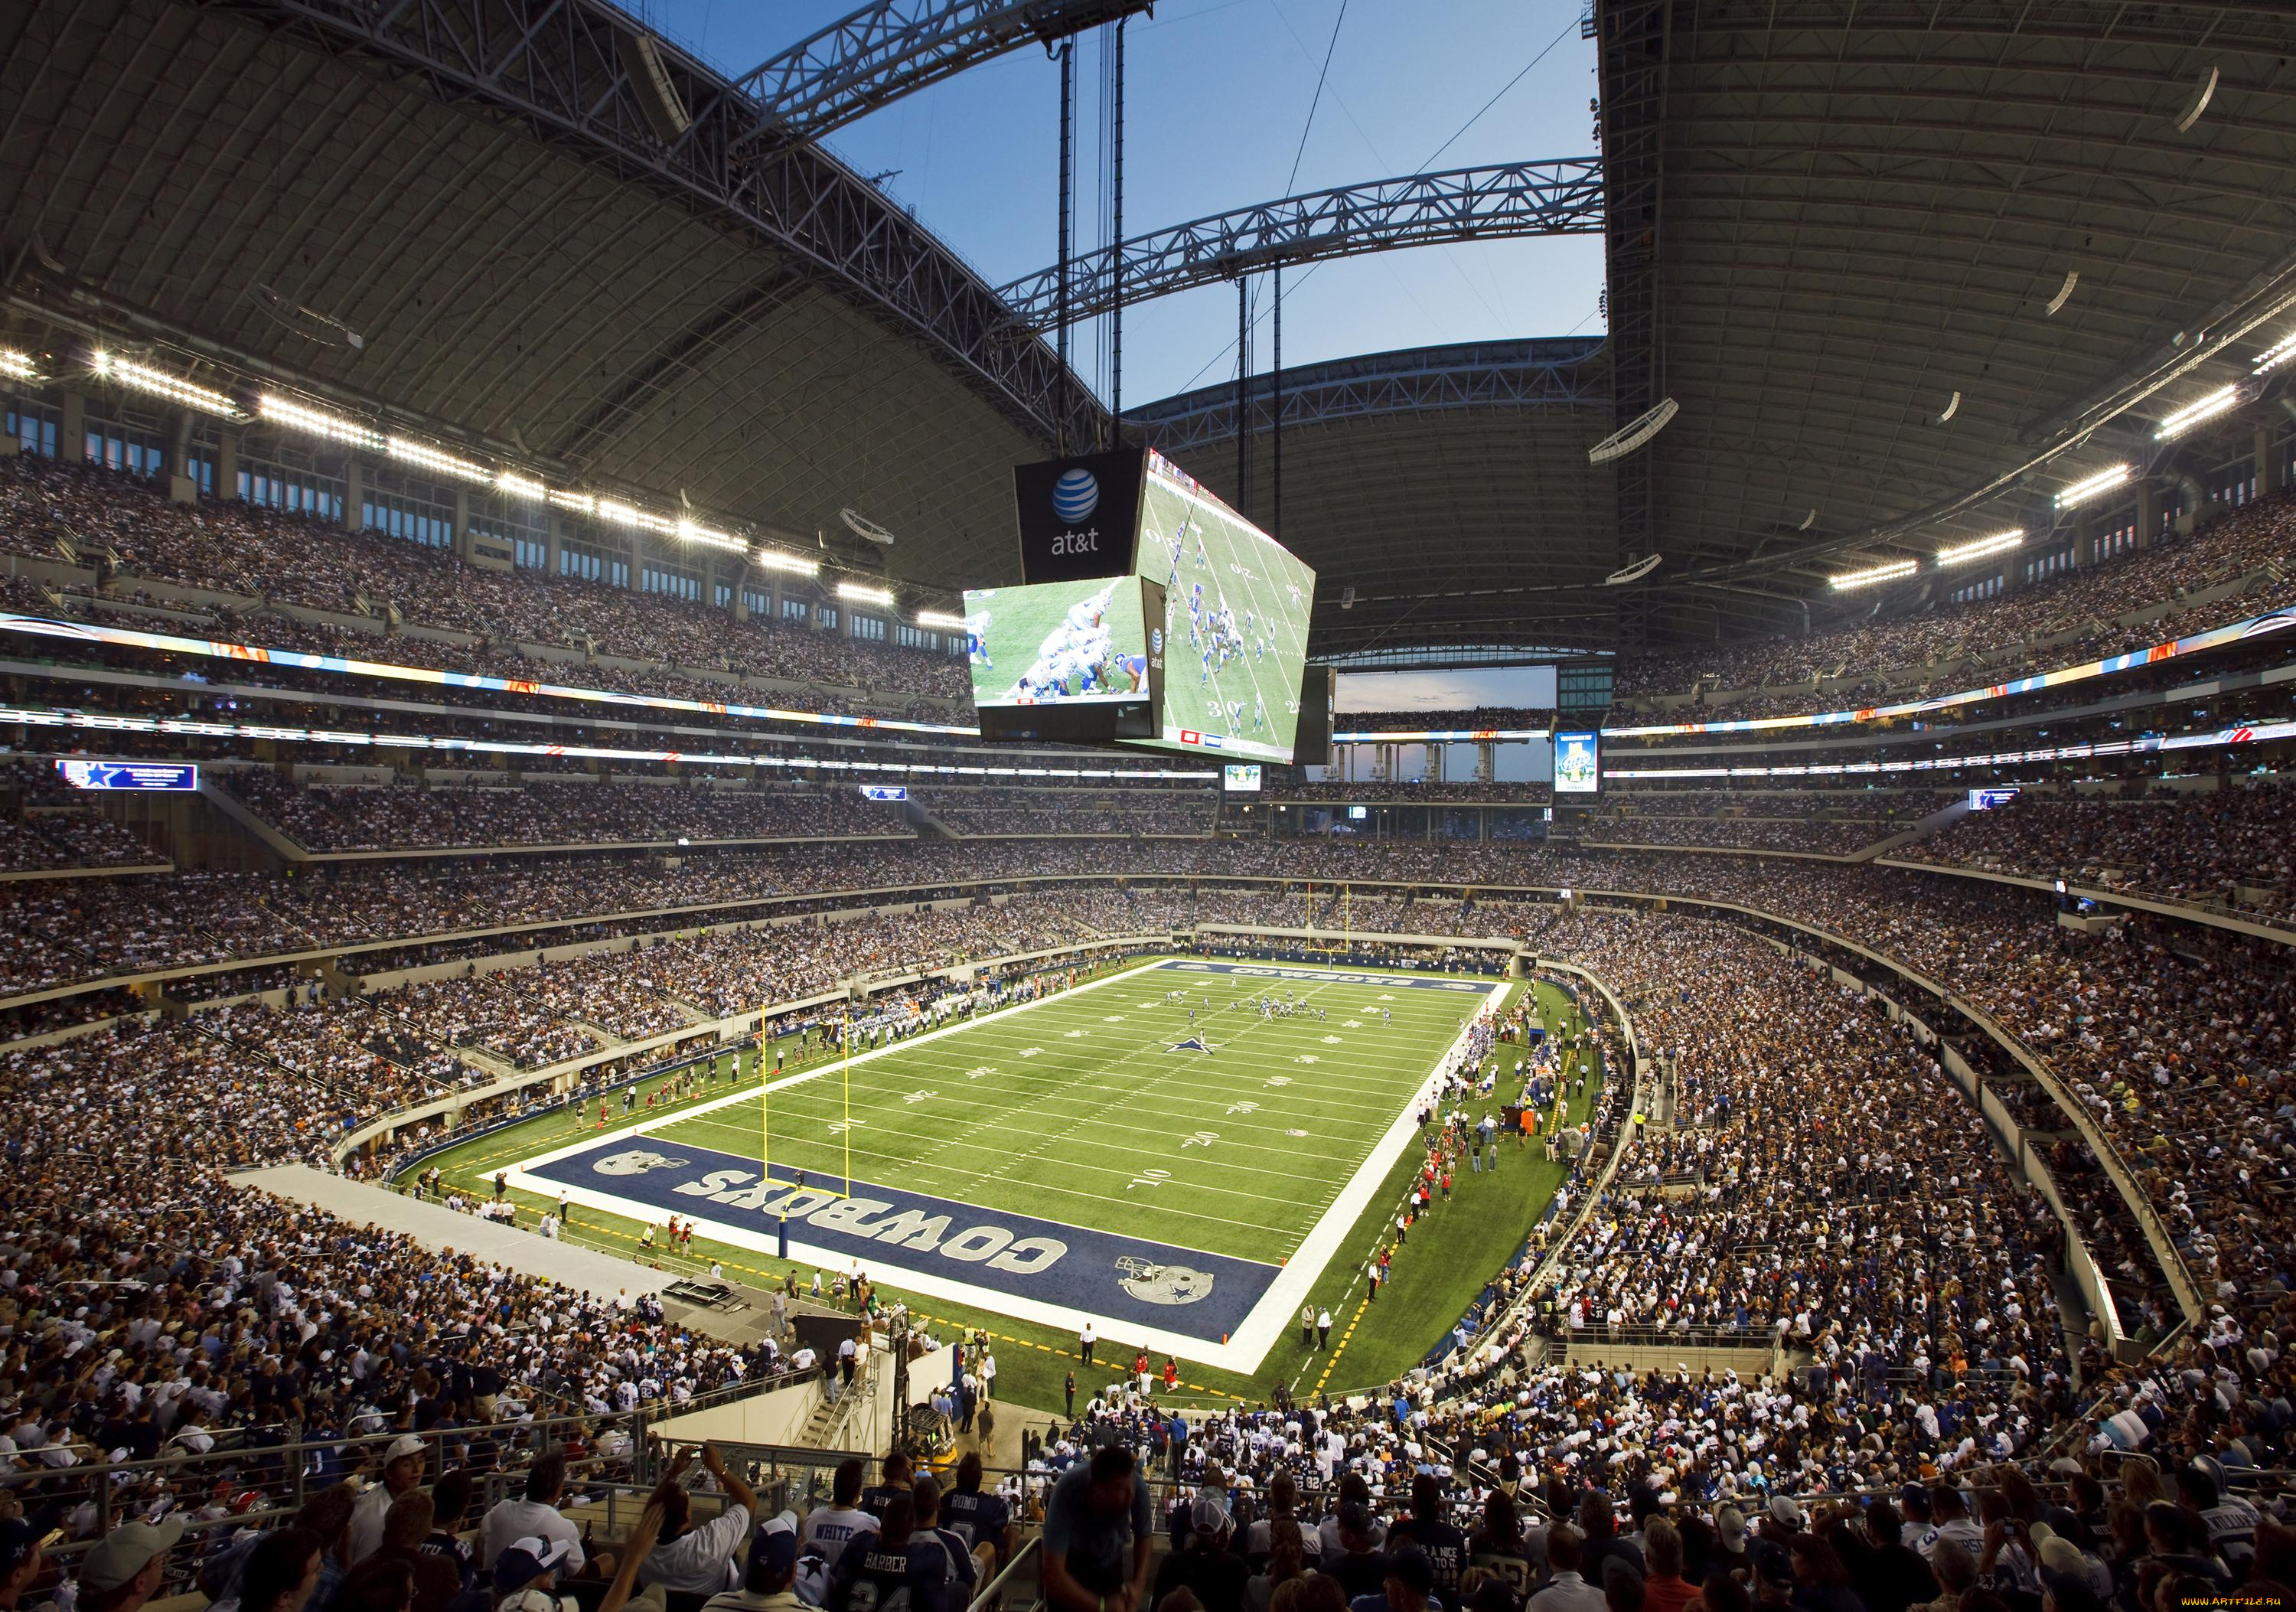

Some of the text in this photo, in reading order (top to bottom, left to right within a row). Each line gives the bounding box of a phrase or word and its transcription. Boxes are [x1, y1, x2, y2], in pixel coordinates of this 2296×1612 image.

[1052, 528, 1098, 555] at&t
[1151, 657, 1163, 670] at&t
[1230, 967, 1415, 986] COWBOYS
[1228, 1101, 1260, 1114] 30
[1184, 1131, 1220, 1147] 20
[1132, 1169, 1172, 1187] 10
[672, 1170, 1068, 1274] COWBOYS
[873, 1495, 892, 1507] ROM
[951, 1493, 978, 1511] ROMO
[816, 1524, 854, 1542] WHITE
[1430, 1546, 1437, 1557] A
[1440, 1546, 1457, 1558] NICE
[864, 1552, 907, 1573] BARBER
